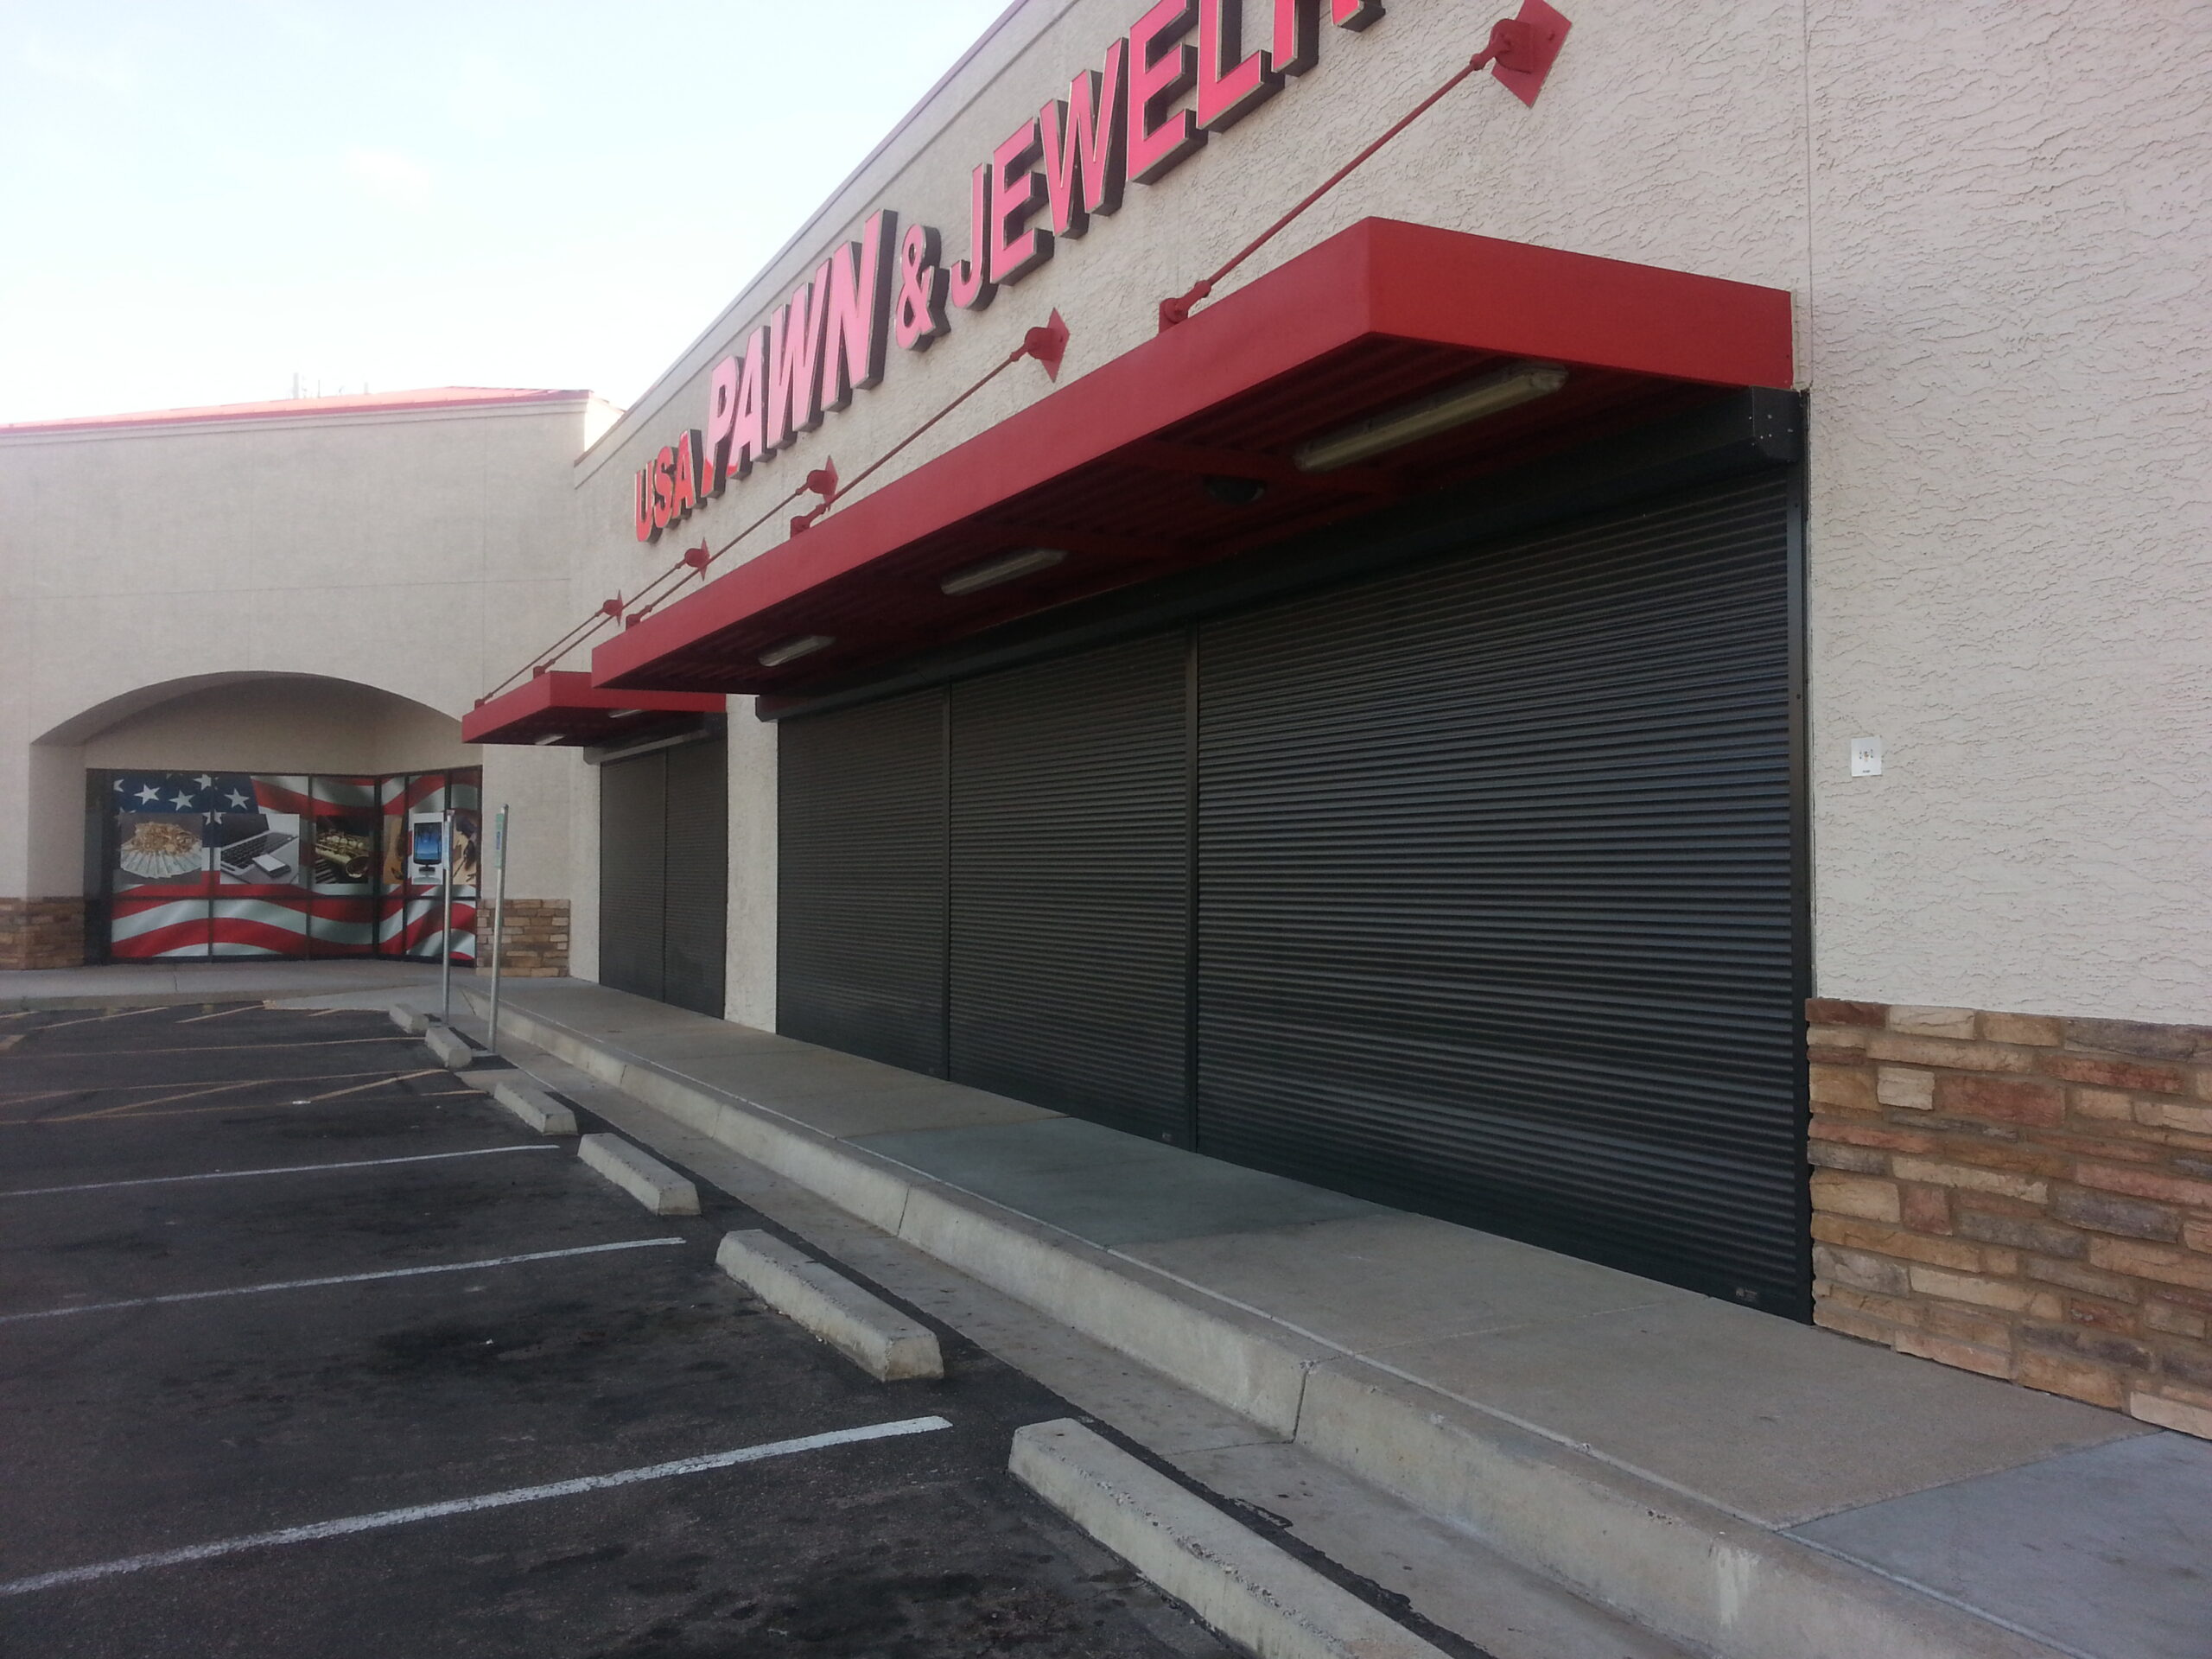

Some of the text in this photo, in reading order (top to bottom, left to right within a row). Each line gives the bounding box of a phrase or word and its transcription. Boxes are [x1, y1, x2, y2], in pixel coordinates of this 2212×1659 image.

[634, 430, 703, 543] USA
[701, 209, 895, 498] PAWN
[894, 225, 950, 350] &
